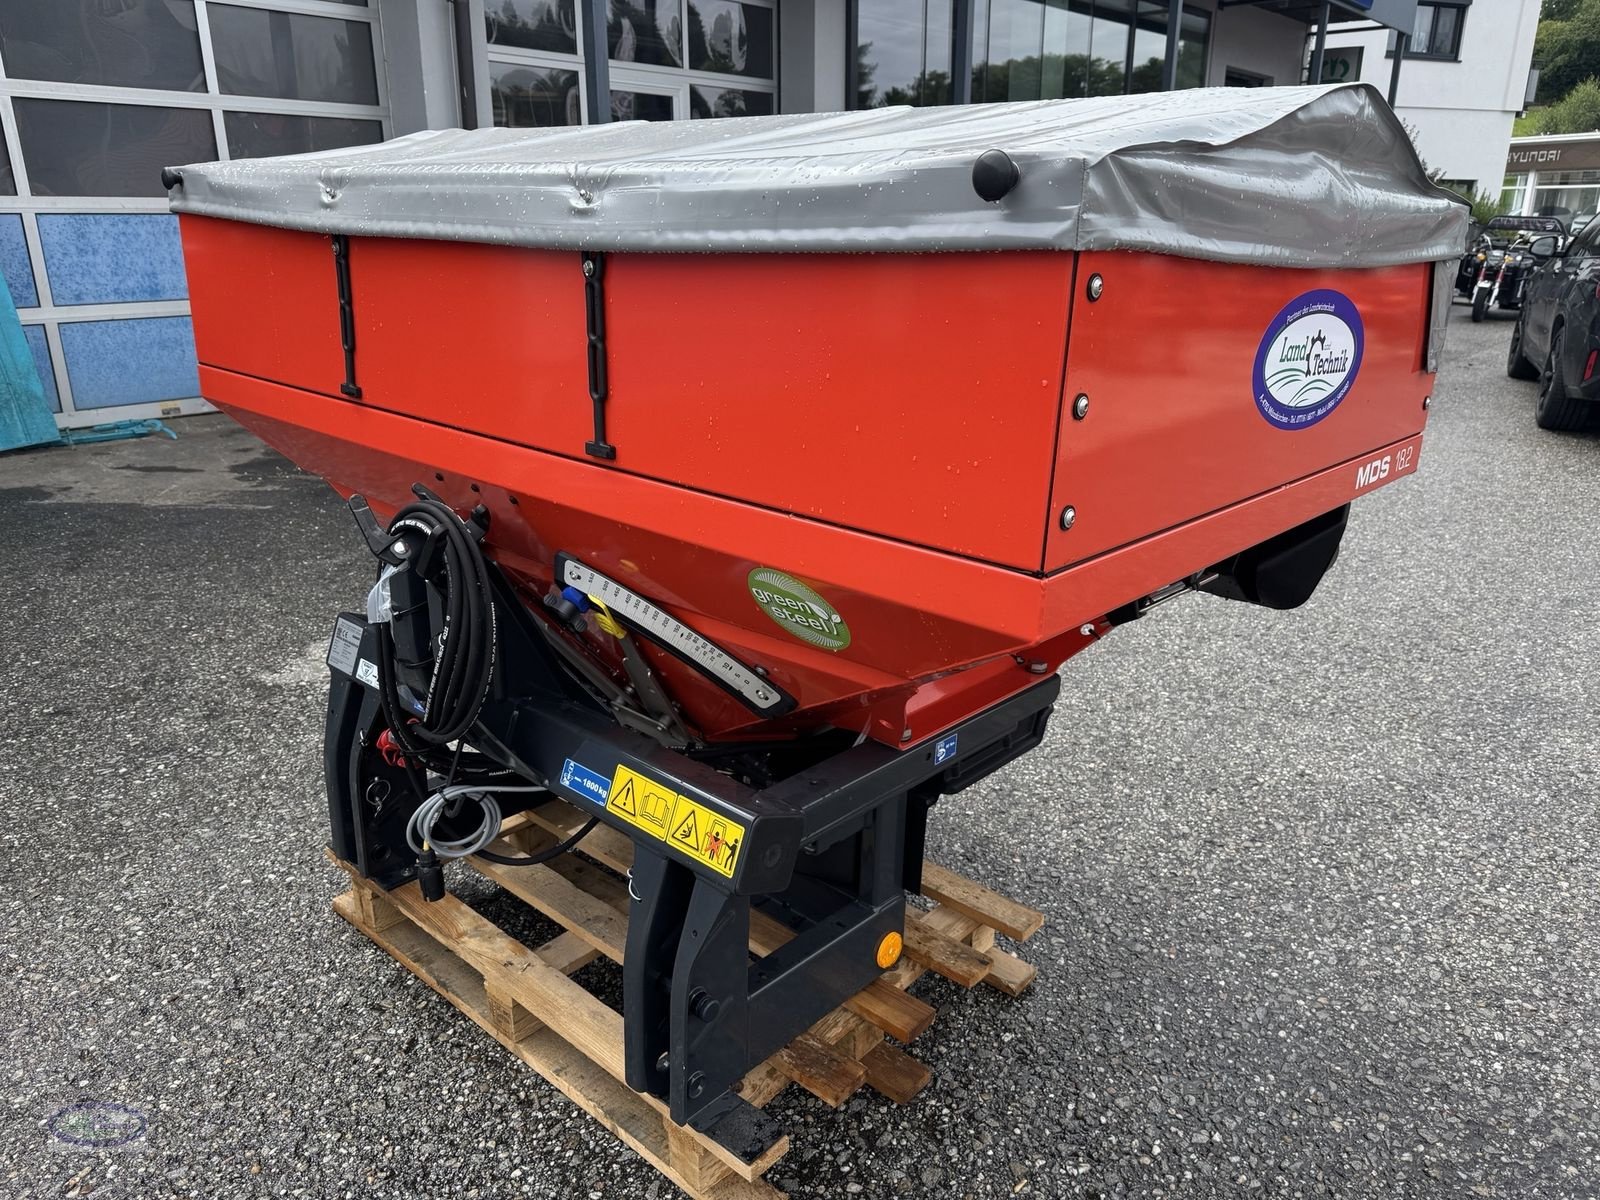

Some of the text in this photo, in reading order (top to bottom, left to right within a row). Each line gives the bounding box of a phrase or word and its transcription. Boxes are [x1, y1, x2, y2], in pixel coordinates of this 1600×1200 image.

[1280, 336, 1309, 362] Land
[1312, 349, 1348, 376] Technik
[1355, 456, 1391, 489] MDS
[752, 587, 811, 614] green
[772, 607, 829, 633] steel
[599, 786, 607, 798] kg
